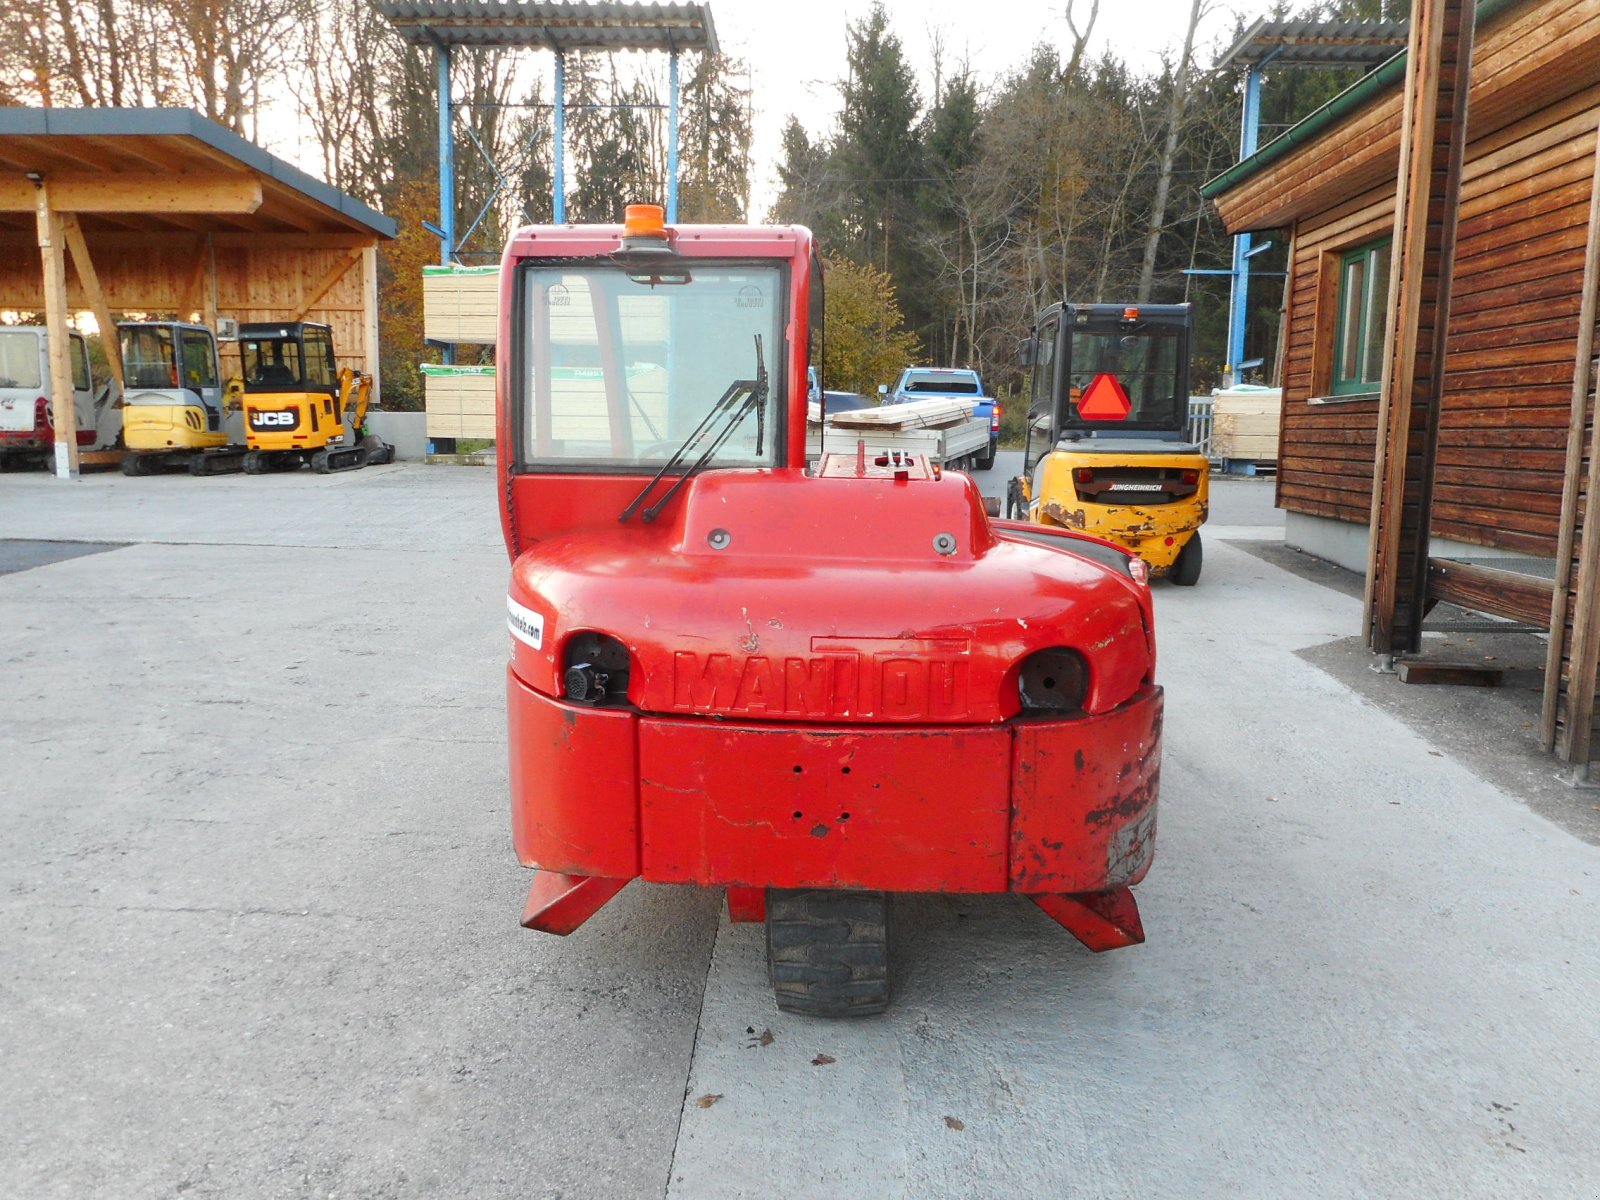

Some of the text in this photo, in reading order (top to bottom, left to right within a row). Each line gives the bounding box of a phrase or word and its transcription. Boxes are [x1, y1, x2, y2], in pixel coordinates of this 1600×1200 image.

[253, 412, 294, 426] JCB
[1110, 483, 1162, 492] JUNGHEINRICH
[673, 637, 970, 721] MANITOU
